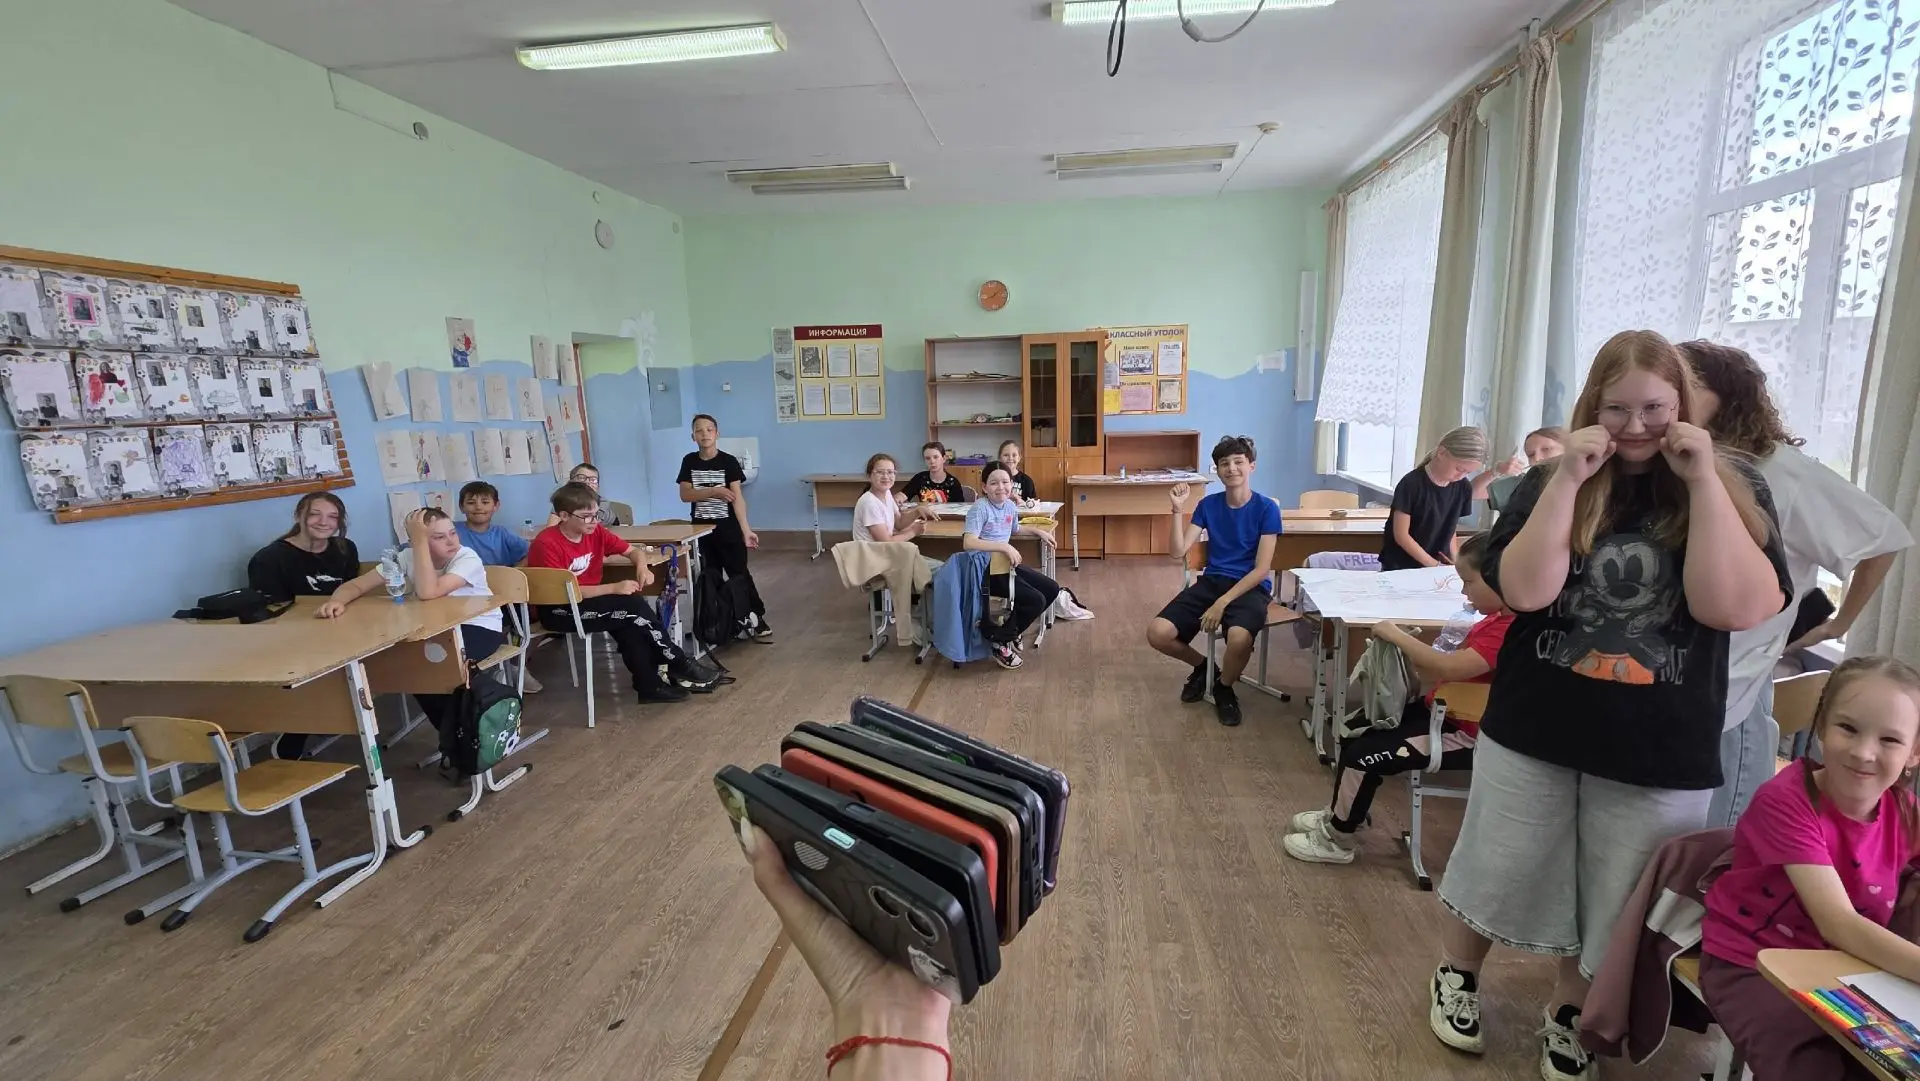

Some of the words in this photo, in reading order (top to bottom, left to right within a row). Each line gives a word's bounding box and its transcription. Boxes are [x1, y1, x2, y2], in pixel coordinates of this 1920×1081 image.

[808, 328, 867, 337] ИНФОРМАЦИЯ
[1109, 328, 1152, 338] КЛАССНЫЙ
[1154, 328, 1184, 337] УГОЛОК
